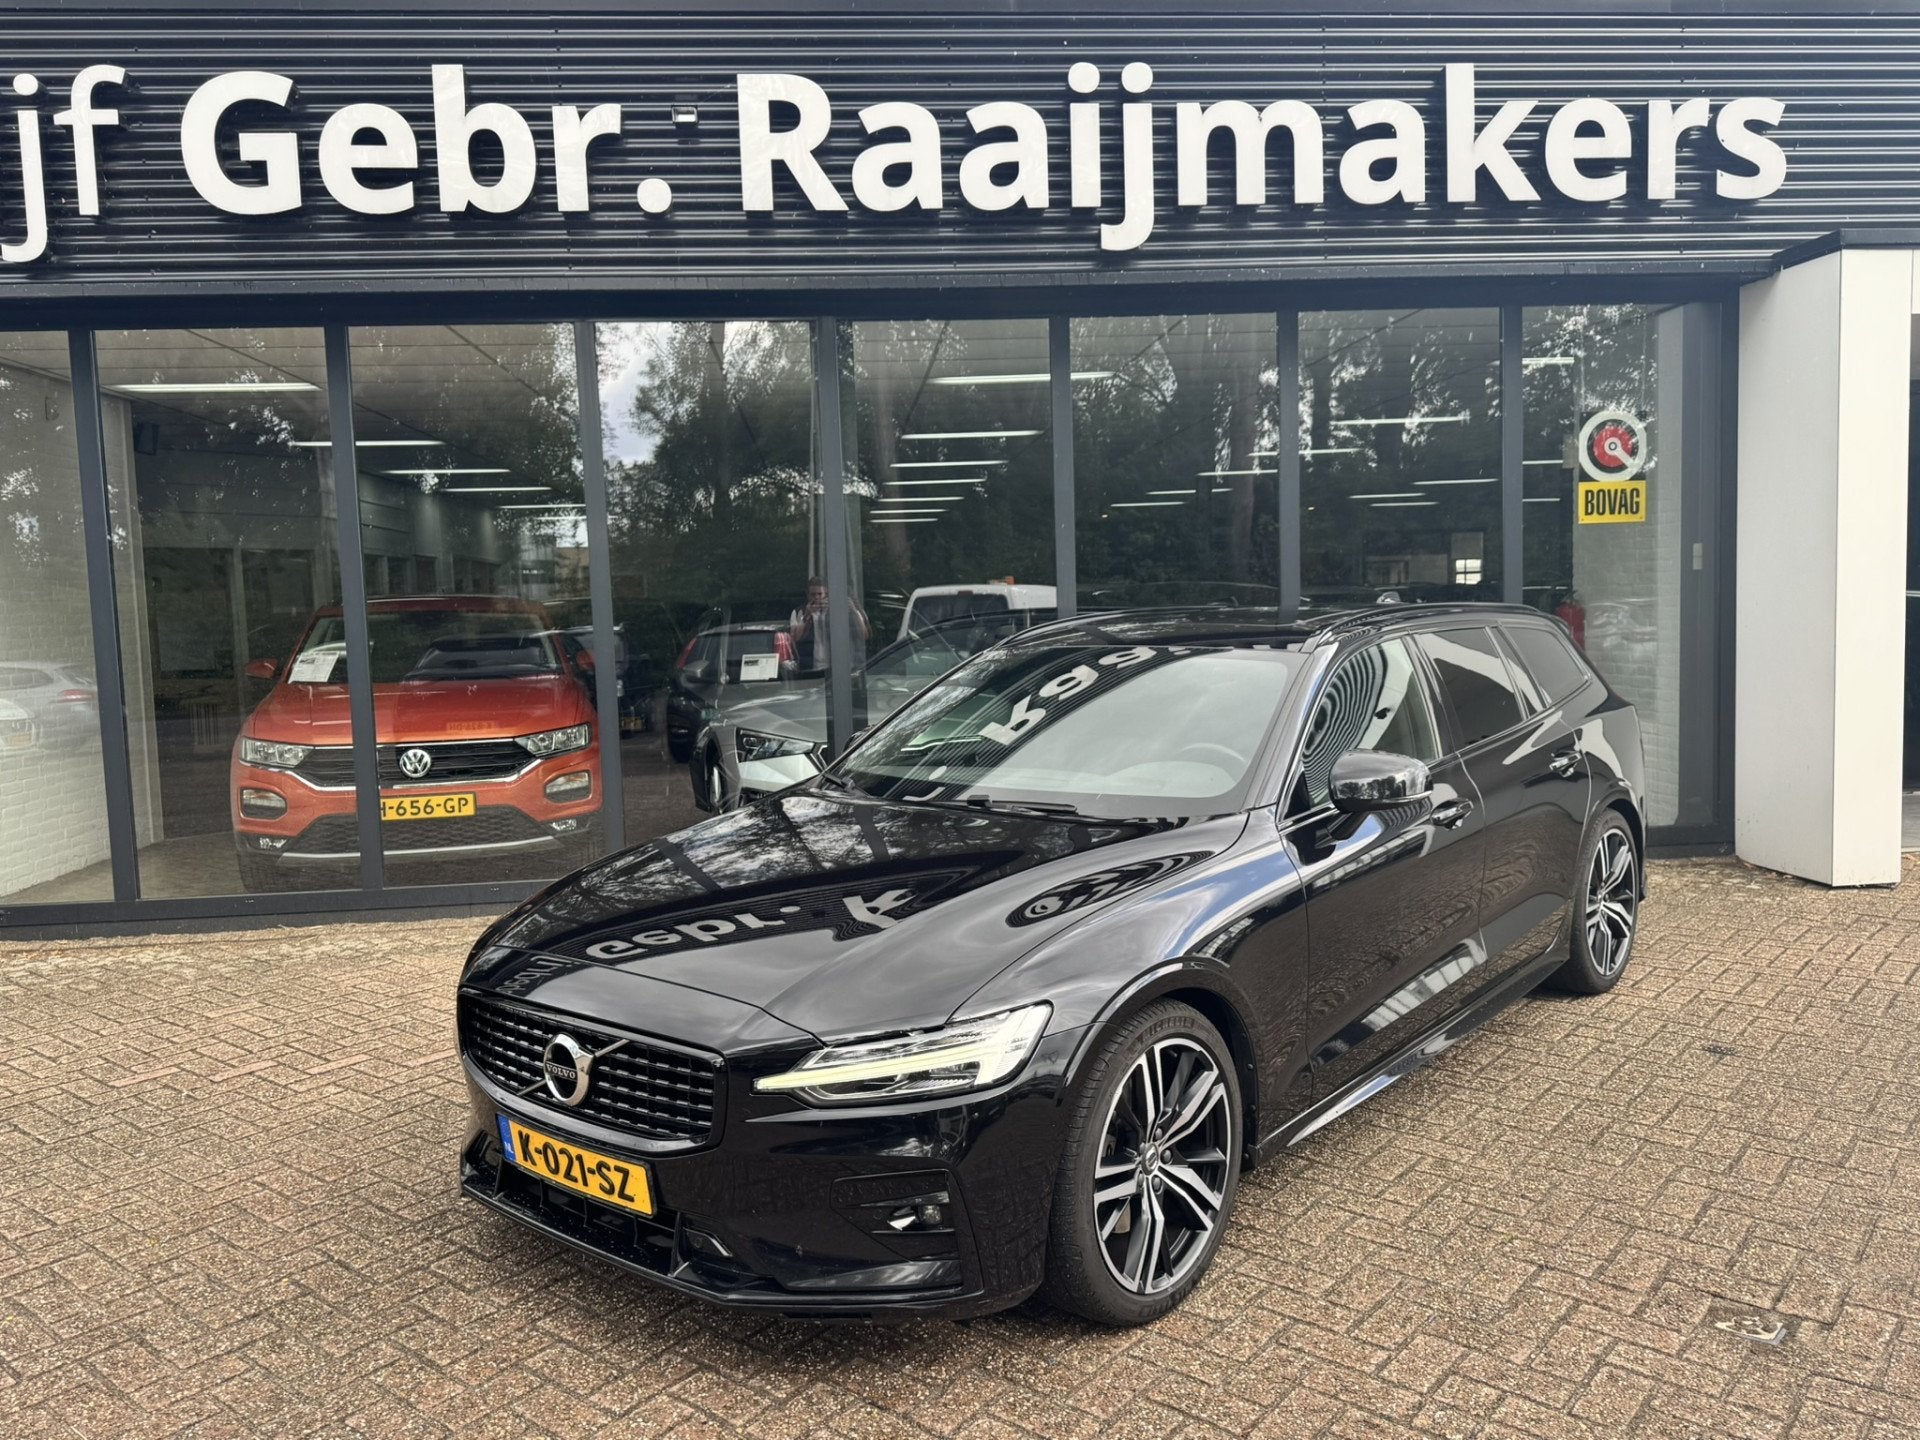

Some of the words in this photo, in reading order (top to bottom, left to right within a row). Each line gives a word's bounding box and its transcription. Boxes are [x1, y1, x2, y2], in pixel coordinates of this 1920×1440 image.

[181, 64, 671, 214] Gebr.
[737, 61, 1787, 252] Raaijmakers
[1585, 488, 1640, 516] BOVAG
[546, 1063, 576, 1079] VOLVO
[518, 1130, 635, 1202] K-021-SZ
